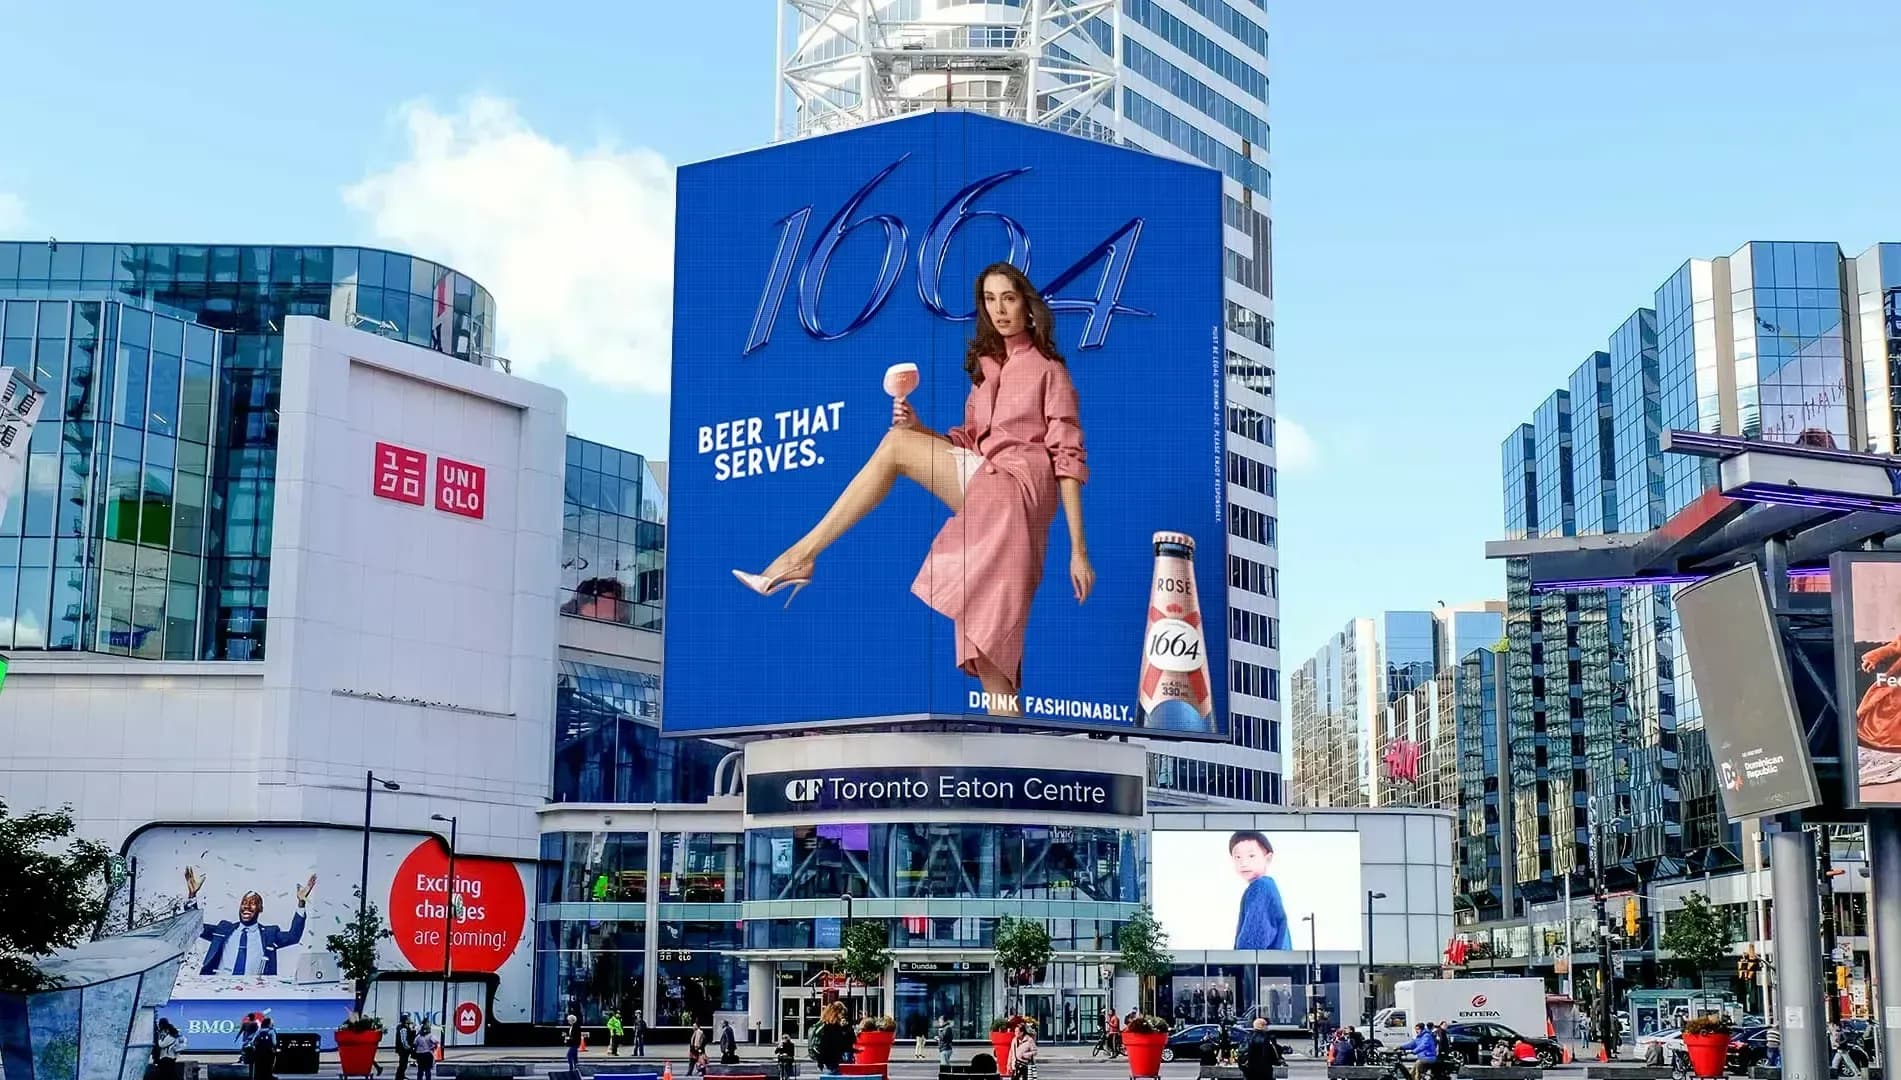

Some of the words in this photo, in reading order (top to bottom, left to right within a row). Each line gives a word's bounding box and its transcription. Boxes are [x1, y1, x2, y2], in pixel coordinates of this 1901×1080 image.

[742, 151, 1157, 358] 1664
[1212, 346, 1219, 354] BE
[698, 417, 763, 454] BEER
[774, 401, 845, 440] THAT
[714, 438, 825, 481] SERVES.
[443, 465, 477, 490] UNI
[442, 486, 479, 511] QLO
[1157, 576, 1193, 595] ROSÉ
[1149, 631, 1201, 661] 1664
[1876, 672, 1901, 687] Fe
[969, 691, 1019, 712] DRINK
[1025, 696, 1134, 722] FASHIONABLY.
[1744, 755, 1784, 771] Dominican
[1746, 765, 1779, 779] Republic
[785, 779, 823, 802] CF
[829, 777, 929, 802] Toronto
[939, 776, 1014, 800] Eaton
[1023, 778, 1106, 803] Centre
[416, 873, 482, 898] Exciing
[414, 931, 440, 945] are
[449, 930, 506, 951] oming!
[911, 962, 938, 970] Dundas
[1459, 1010, 1501, 1018] ENTERA
[188, 1019, 235, 1034] BMO
